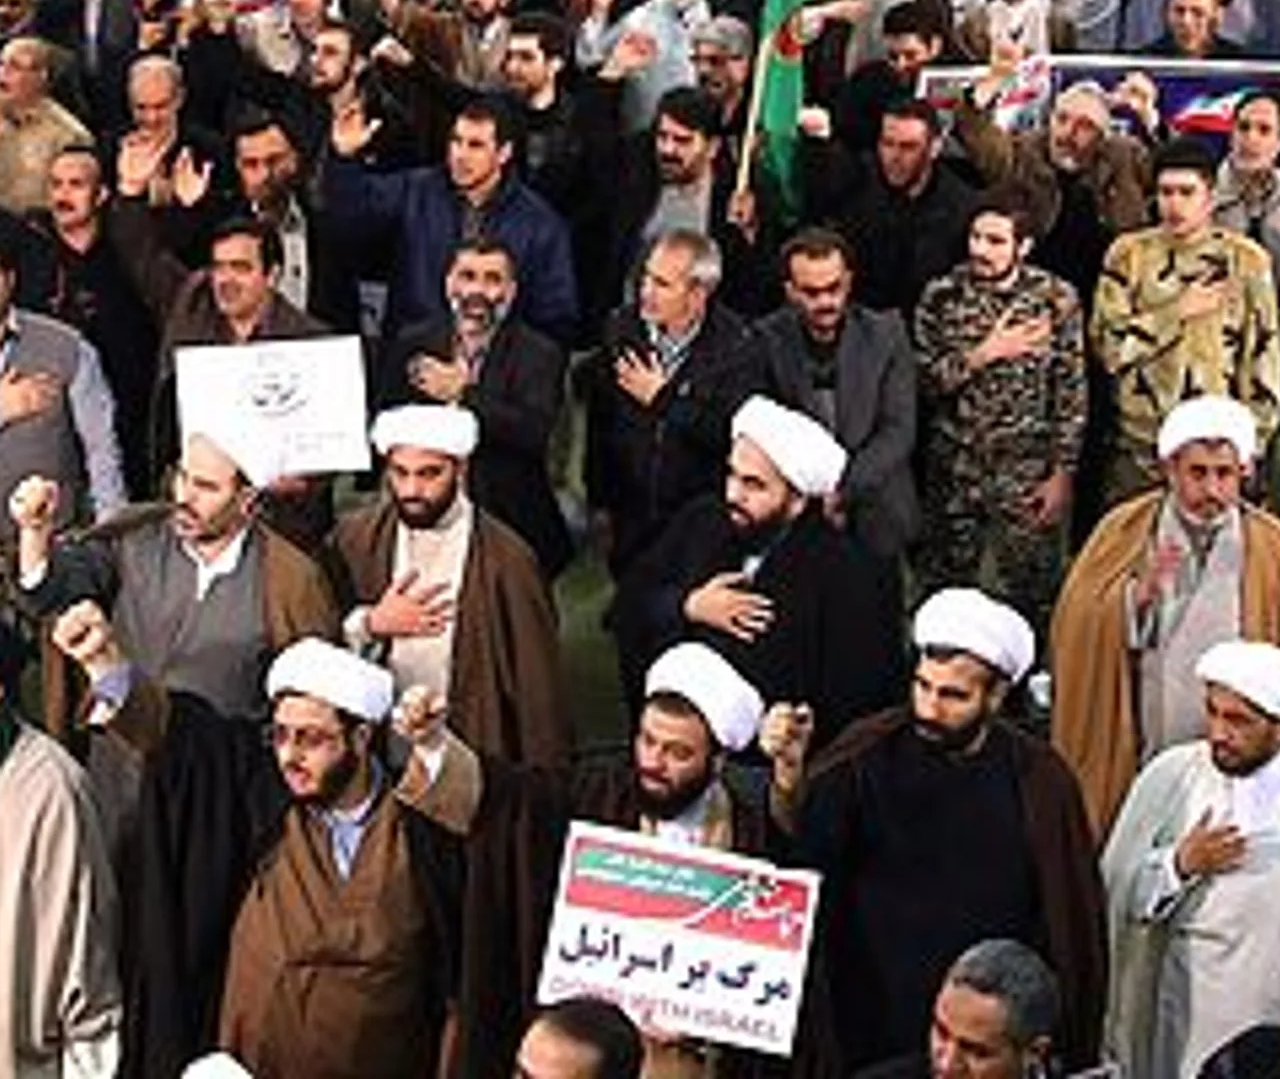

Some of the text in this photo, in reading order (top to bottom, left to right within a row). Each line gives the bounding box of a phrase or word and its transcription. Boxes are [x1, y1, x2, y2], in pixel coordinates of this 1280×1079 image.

[558, 923, 793, 1006] مرگ بر اسرائیل
[694, 1006, 783, 1043] ISRAEL
